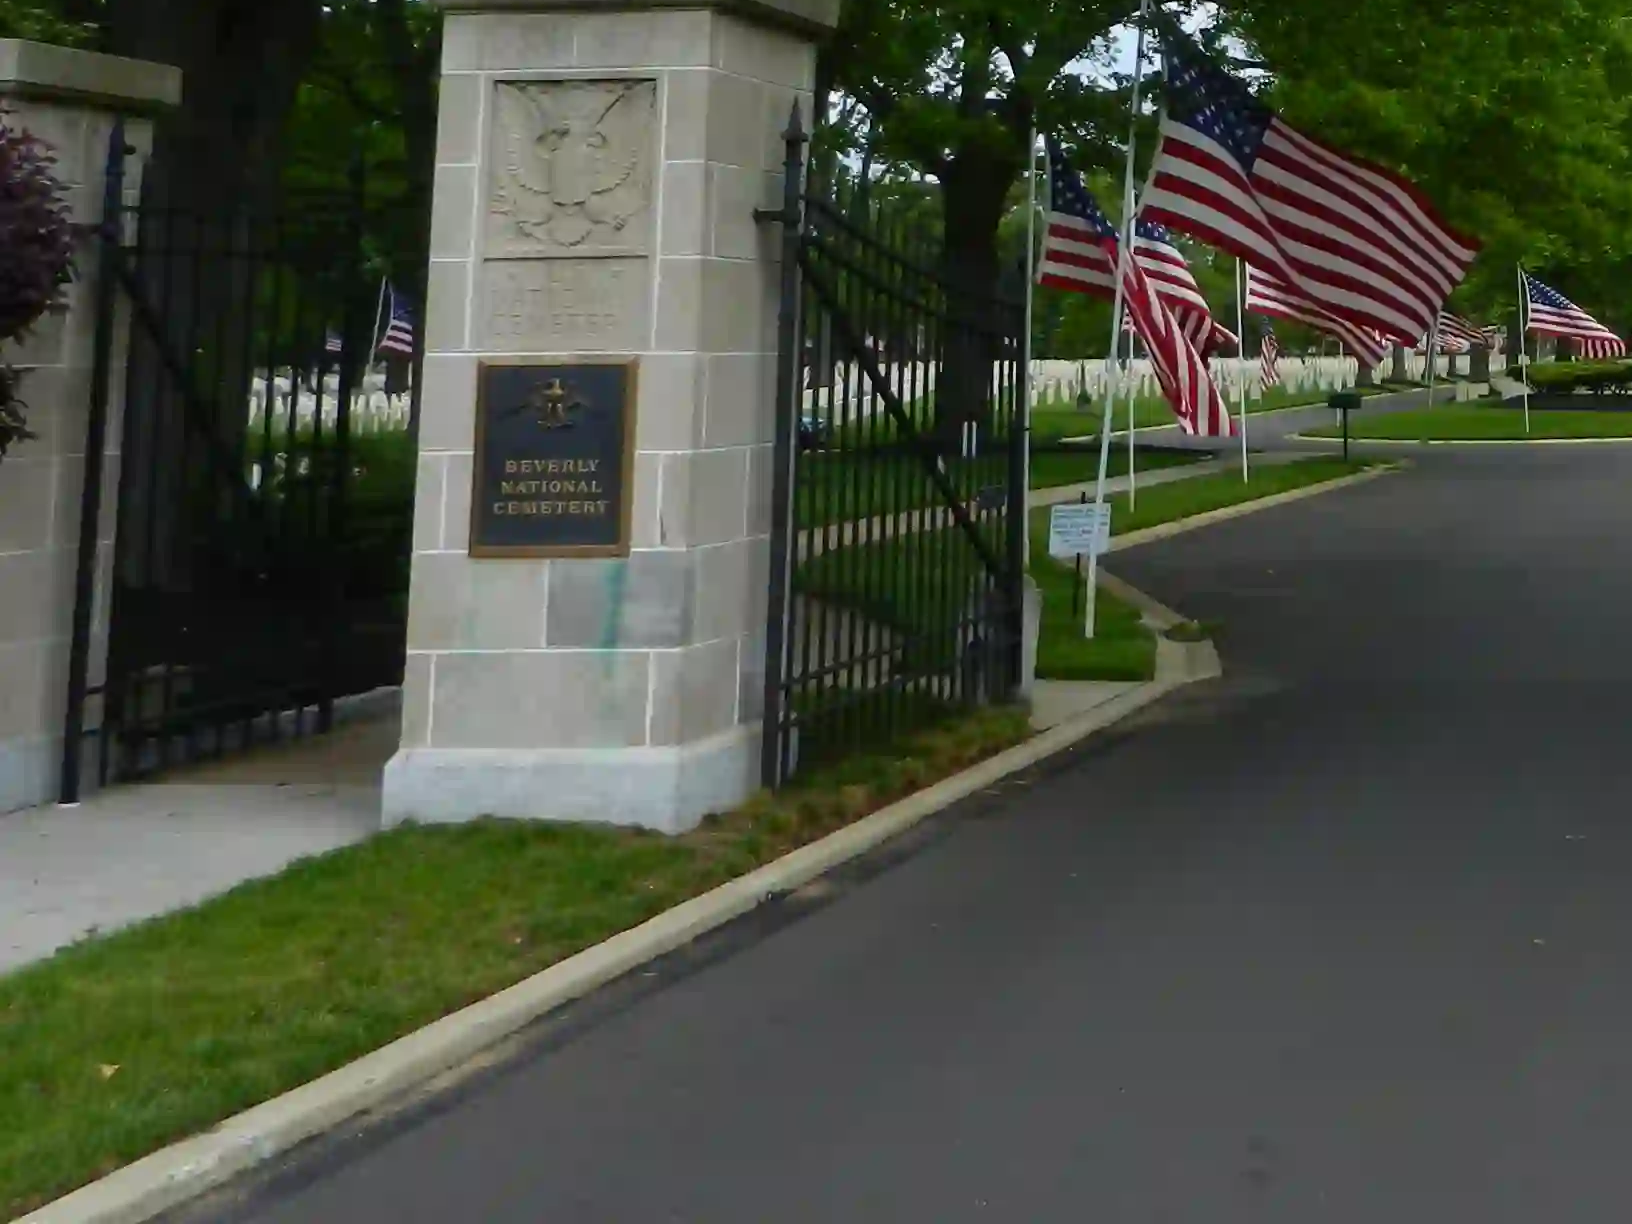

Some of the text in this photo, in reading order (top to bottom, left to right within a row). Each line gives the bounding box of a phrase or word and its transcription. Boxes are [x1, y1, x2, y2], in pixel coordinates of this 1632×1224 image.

[505, 459, 600, 473] BEVERLY
[501, 480, 602, 494] NATIONAL
[493, 500, 611, 515] CEMETERY
